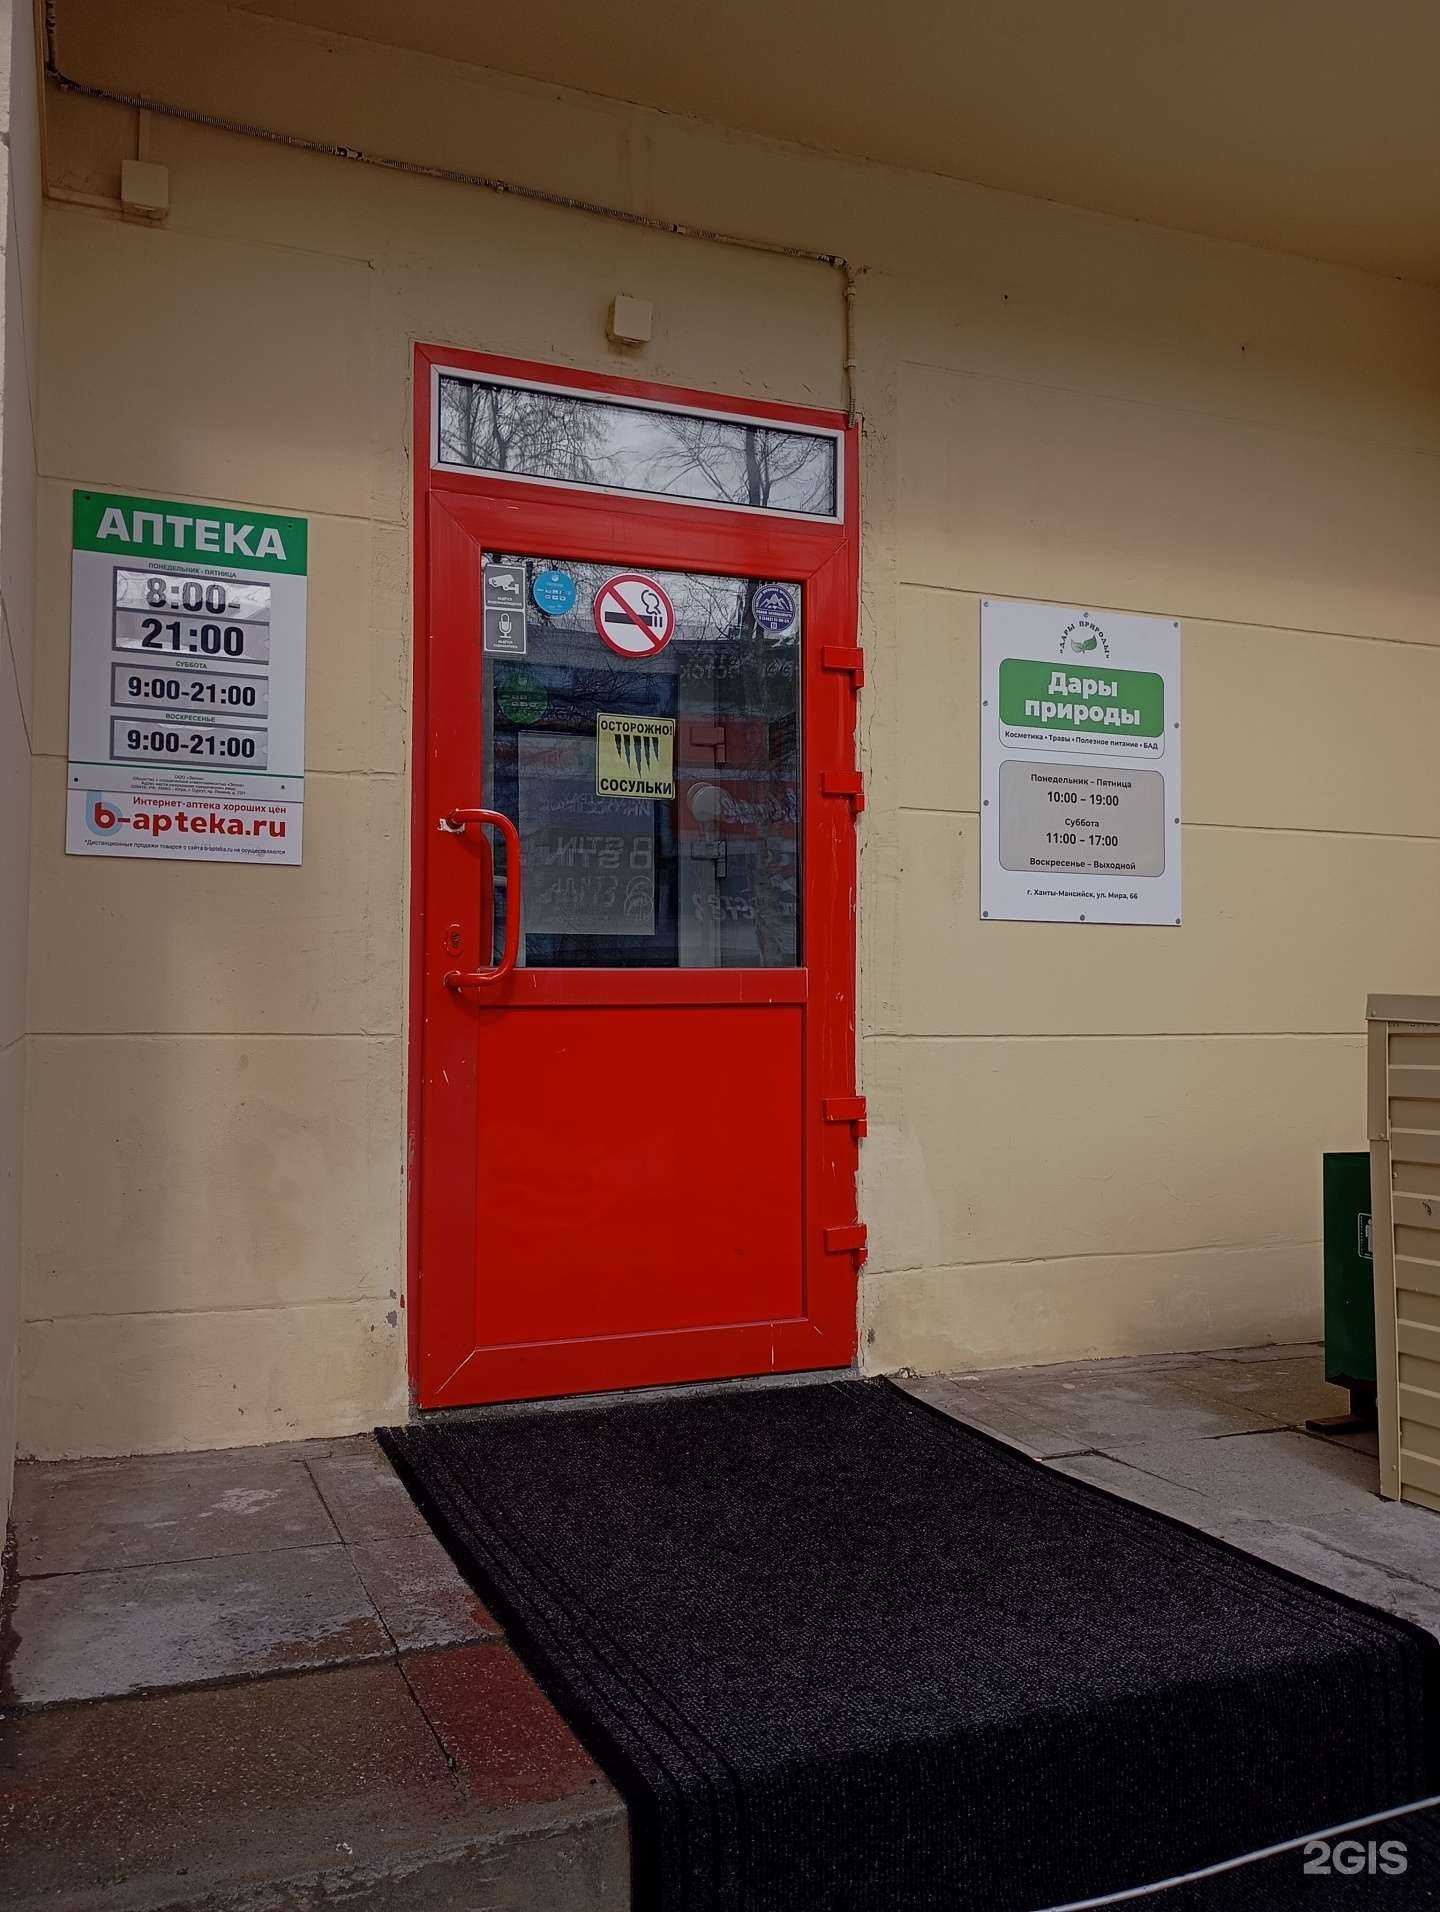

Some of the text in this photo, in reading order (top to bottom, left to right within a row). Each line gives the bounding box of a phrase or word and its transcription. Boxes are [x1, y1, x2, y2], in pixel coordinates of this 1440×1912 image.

[96, 507, 287, 561] АПТЕКА
[148, 562, 200, 574] ПОНЕДЕЛЬНИК
[204, 569, 237, 578] ПЯТНИЦА
[146, 577, 241, 614] 8:00-
[141, 618, 244, 657] 21:00
[175, 660, 208, 669] СУББОТА
[128, 676, 256, 706] 9:00-21:00
[1048, 671, 1118, 699] Дары
[165, 713, 216, 723] ВОСКРЕСЕНЬЕ
[1025, 699, 1141, 726] природы
[600, 719, 673, 736] ОСТОРОЖНО!
[127, 729, 255, 759] 9:00-21:00
[1004, 730, 1159, 750] Косметика Травы Полезное питание БАД
[600, 778, 672, 795] СОСУЛЬКИ
[1030, 773, 1089, 785] Понедельник
[1096, 778, 1132, 789] Пятница
[133, 796, 287, 814] Интернет-аптека хороших цен
[1047, 791, 1078, 804] 10:00
[1089, 794, 1119, 806] 19:00
[94, 802, 286, 838] b-apteka.ru
[1064, 818, 1100, 828] Суббота
[1046, 832, 1076, 845] 11:00
[1088, 834, 1119, 847] 17:00
[1029, 857, 1085, 868] Воскресенье
[1093, 860, 1136, 871] Выходной
[1034, 889, 1096, 898] Ханты-Мансийск,
[1096, 891, 1107, 899] ул.
[1108, 891, 1129, 900] Мира,
